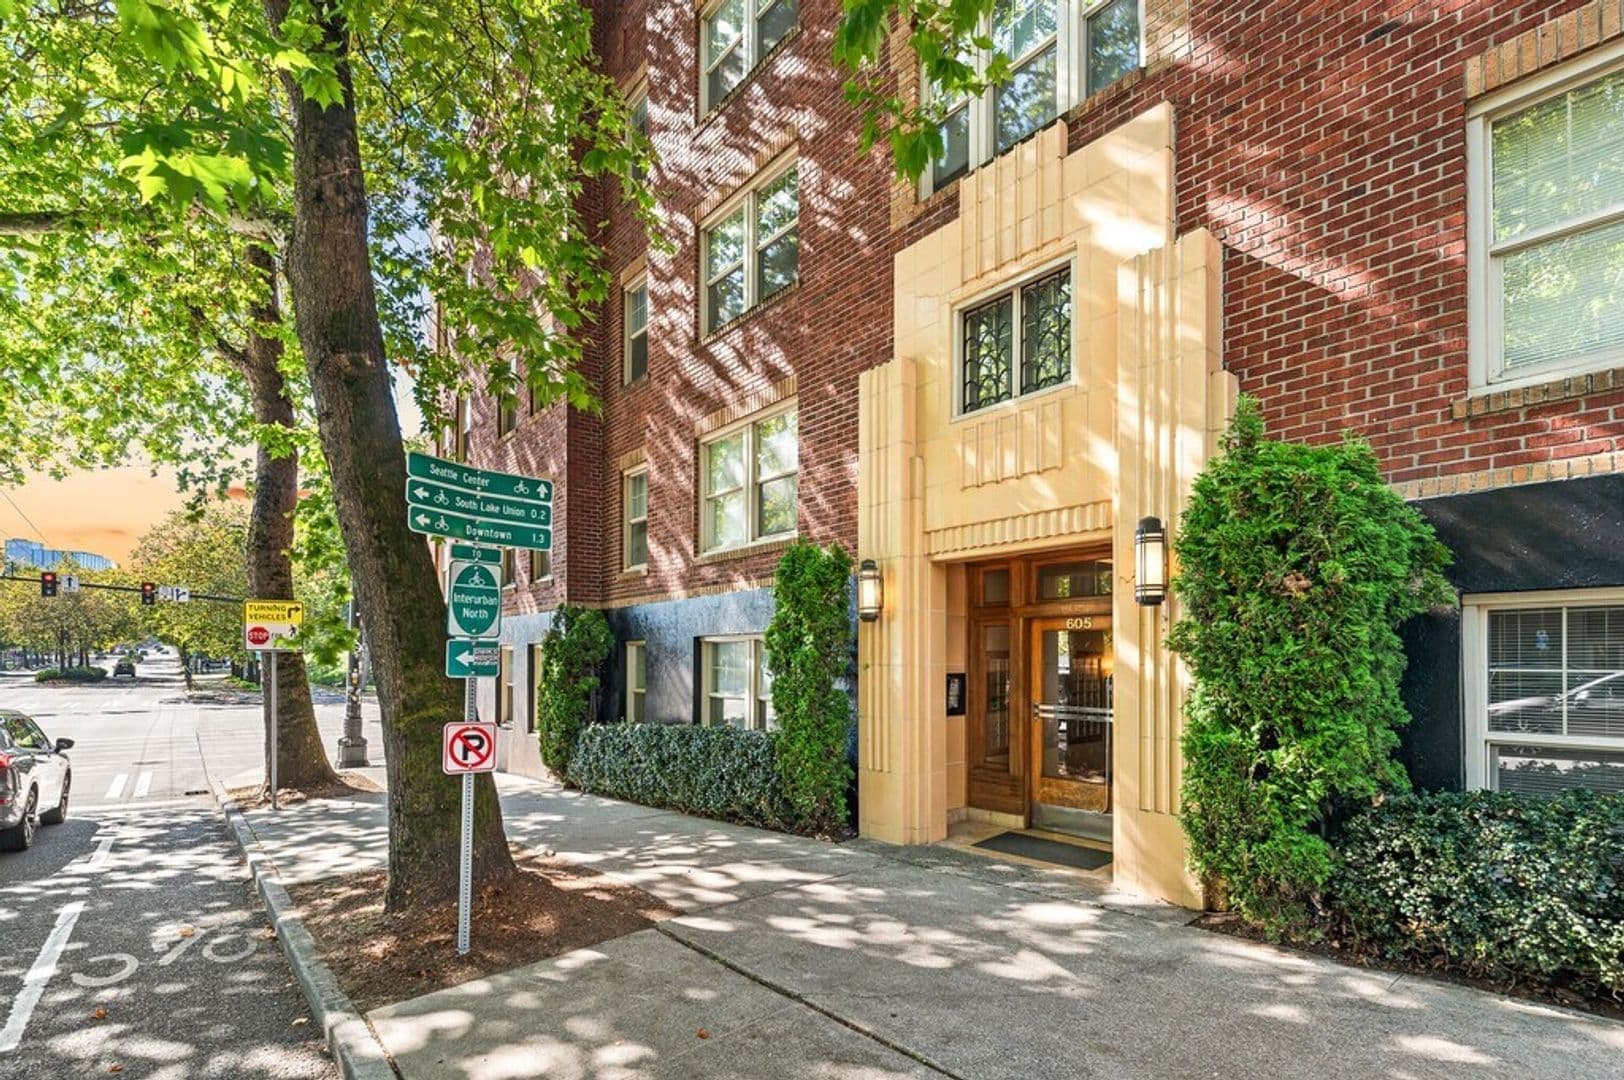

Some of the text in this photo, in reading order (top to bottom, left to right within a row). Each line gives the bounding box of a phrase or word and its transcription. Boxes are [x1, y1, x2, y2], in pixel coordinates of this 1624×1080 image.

[430, 464, 490, 487] Seattle Center
[455, 496, 547, 520] South Lake Union 0.2
[466, 525, 545, 543] Downtown 1.3
[454, 592, 498, 606] Interurban
[463, 607, 488, 619] North
[1066, 617, 1092, 629] 605
[249, 631, 268, 640] STOP
[462, 734, 485, 760] P
